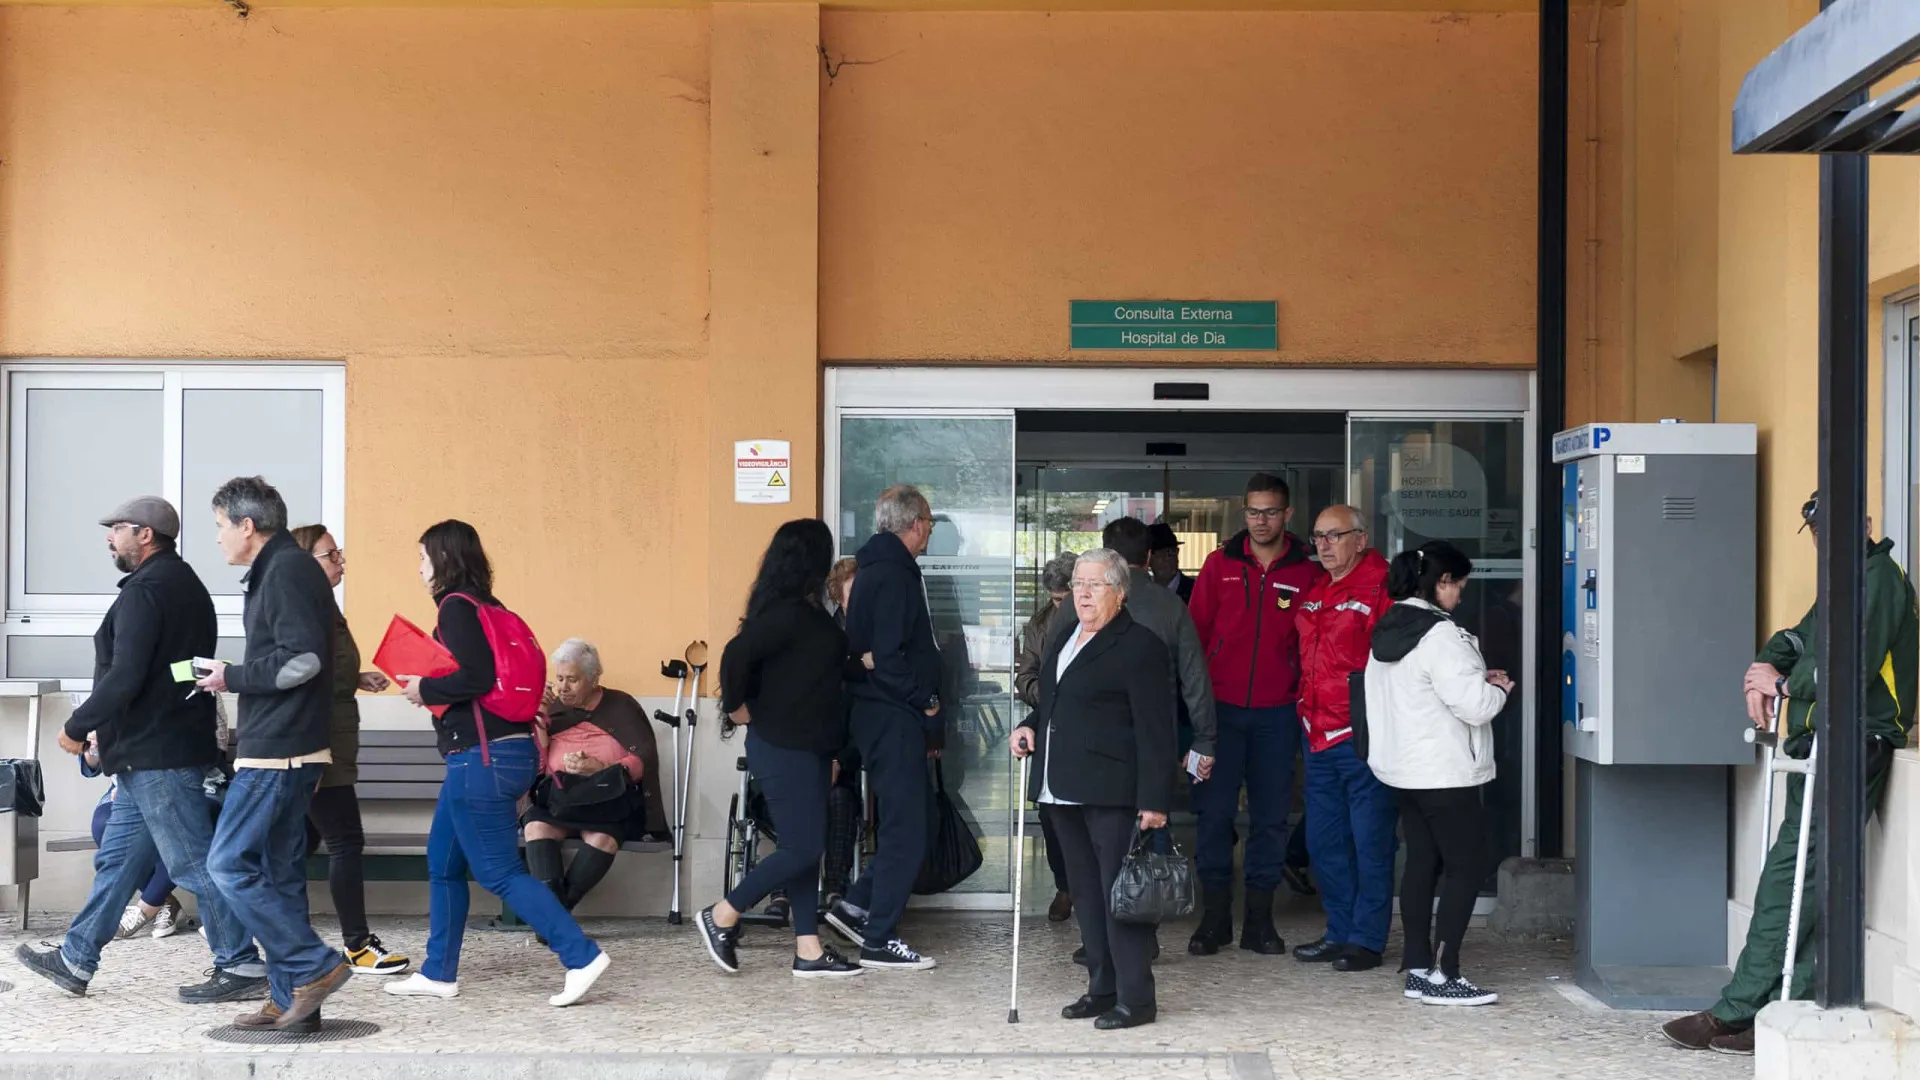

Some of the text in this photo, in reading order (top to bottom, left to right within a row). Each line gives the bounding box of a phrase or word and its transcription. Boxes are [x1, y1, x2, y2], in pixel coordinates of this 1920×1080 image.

[1114, 306, 1233, 321] Consulta Externa
[1121, 331, 1226, 346] Hospital de Dia
[1593, 427, 1611, 449] P
